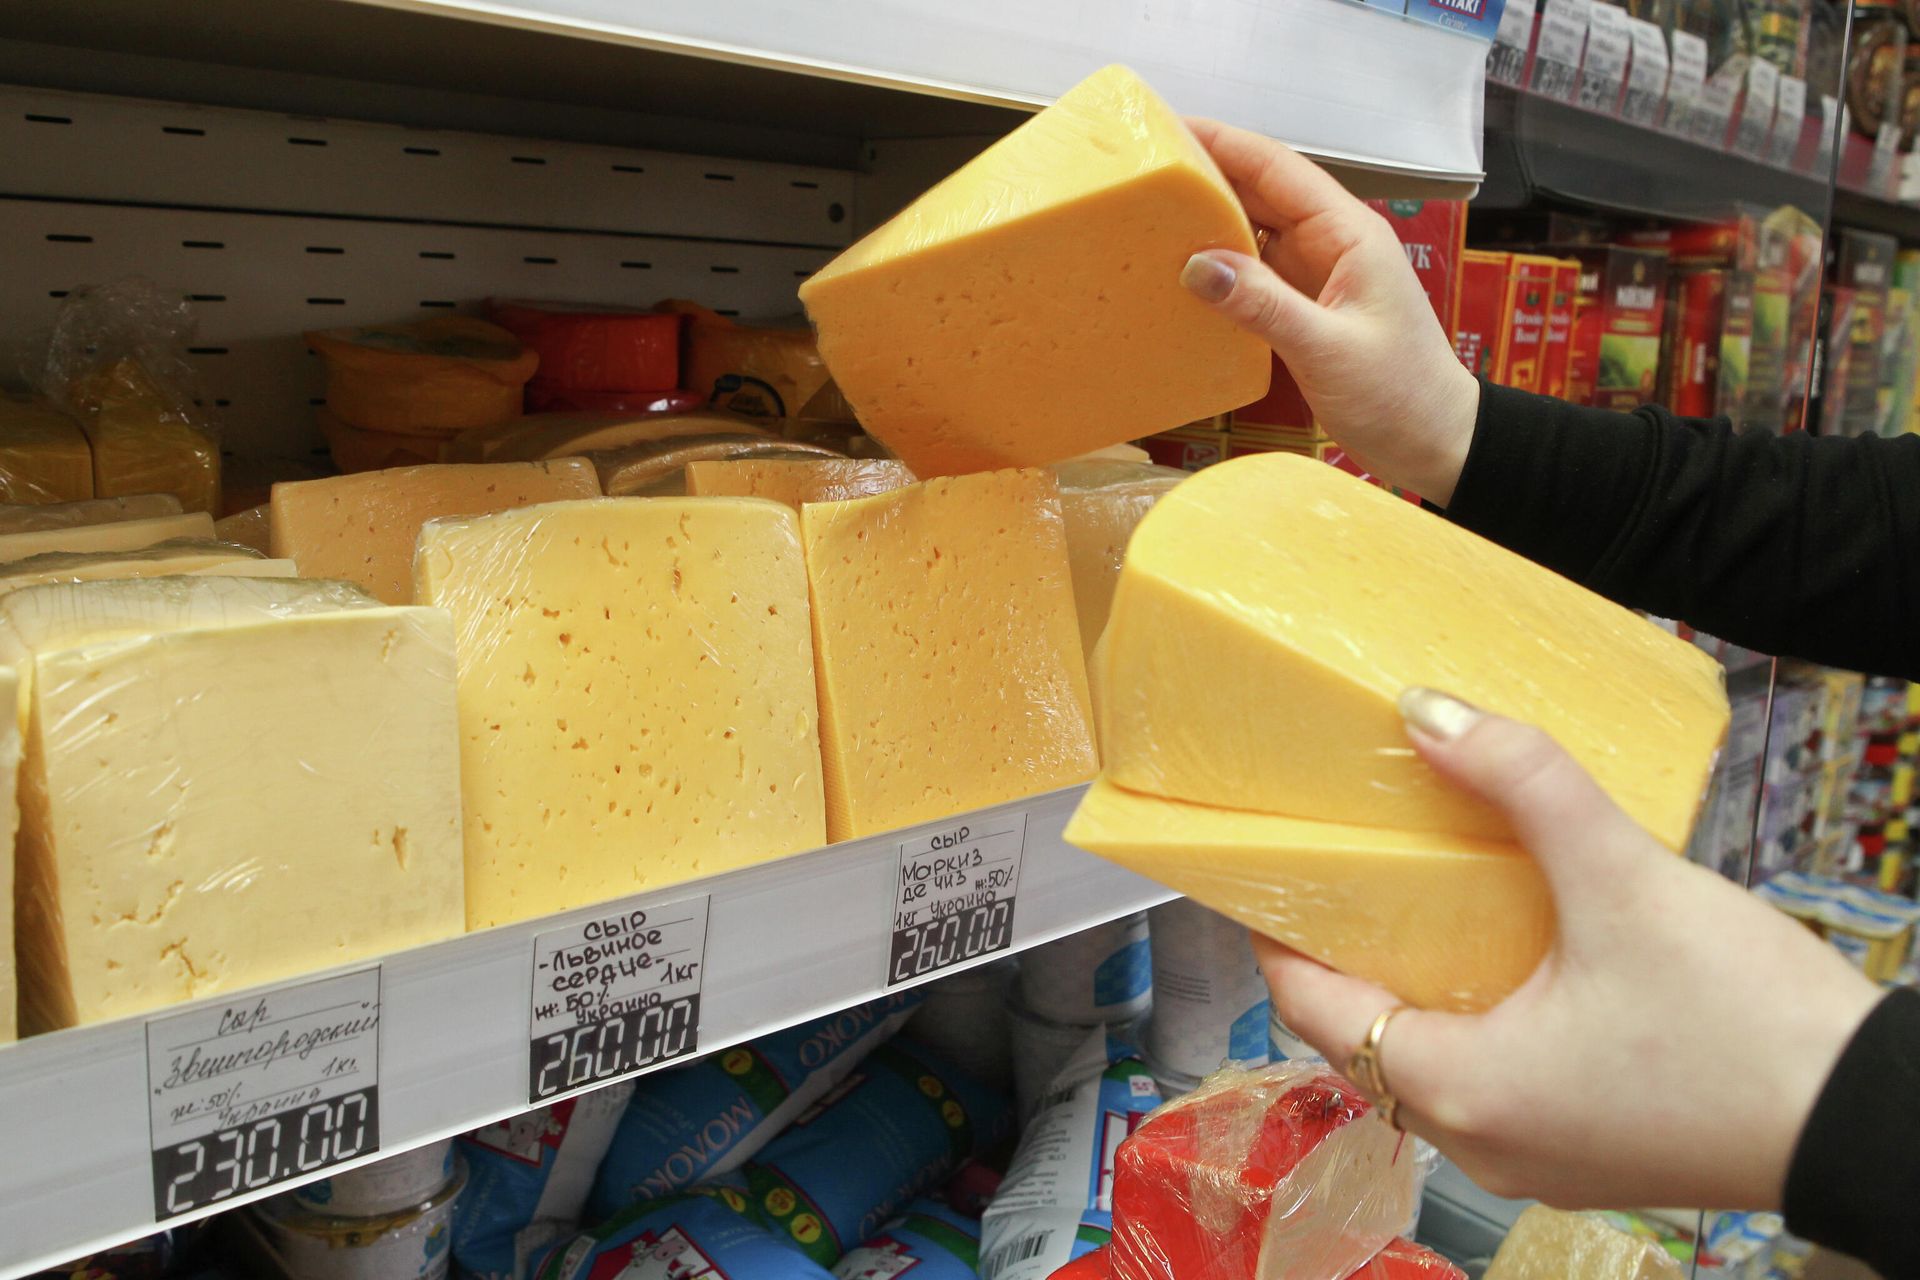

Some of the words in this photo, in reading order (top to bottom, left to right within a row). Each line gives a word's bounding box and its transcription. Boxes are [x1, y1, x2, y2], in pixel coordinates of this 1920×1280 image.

[895, 901, 1009, 981] 260.00
[537, 999, 692, 1097] 260.00
[167, 1093, 368, 1213] 230.00
